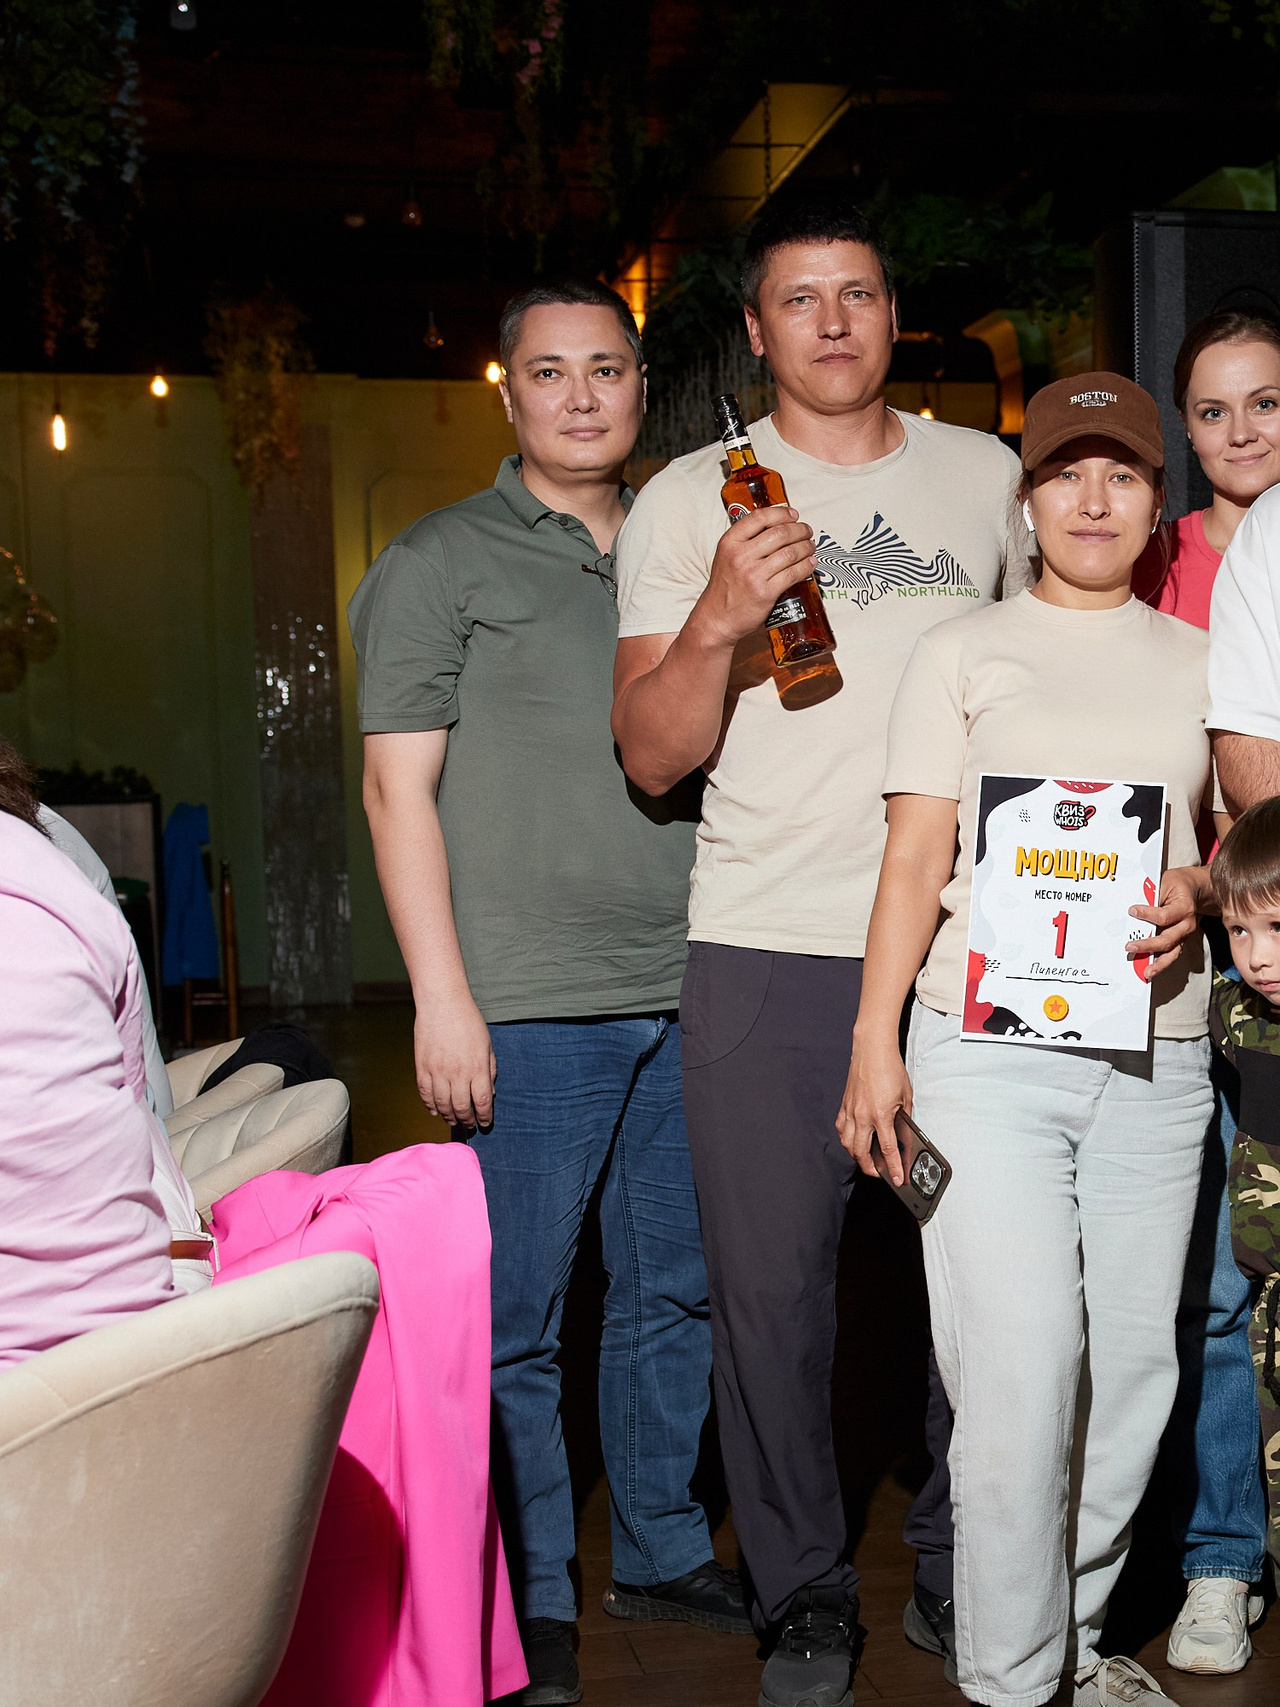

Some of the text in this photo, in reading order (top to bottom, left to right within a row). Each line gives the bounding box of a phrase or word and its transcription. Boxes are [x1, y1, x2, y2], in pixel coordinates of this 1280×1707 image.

[1069, 391, 1118, 405] BOSTON
[822, 580, 980, 611] ATH YOUR NORTHLAND
[1054, 803, 1084, 817] КВИЗ
[1015, 846, 1118, 882] МОЩНО!
[1034, 889, 1093, 903] МЕСТО НОМЕР
[1052, 910, 1069, 958] 1
[1030, 962, 1090, 977] Пиленгас
